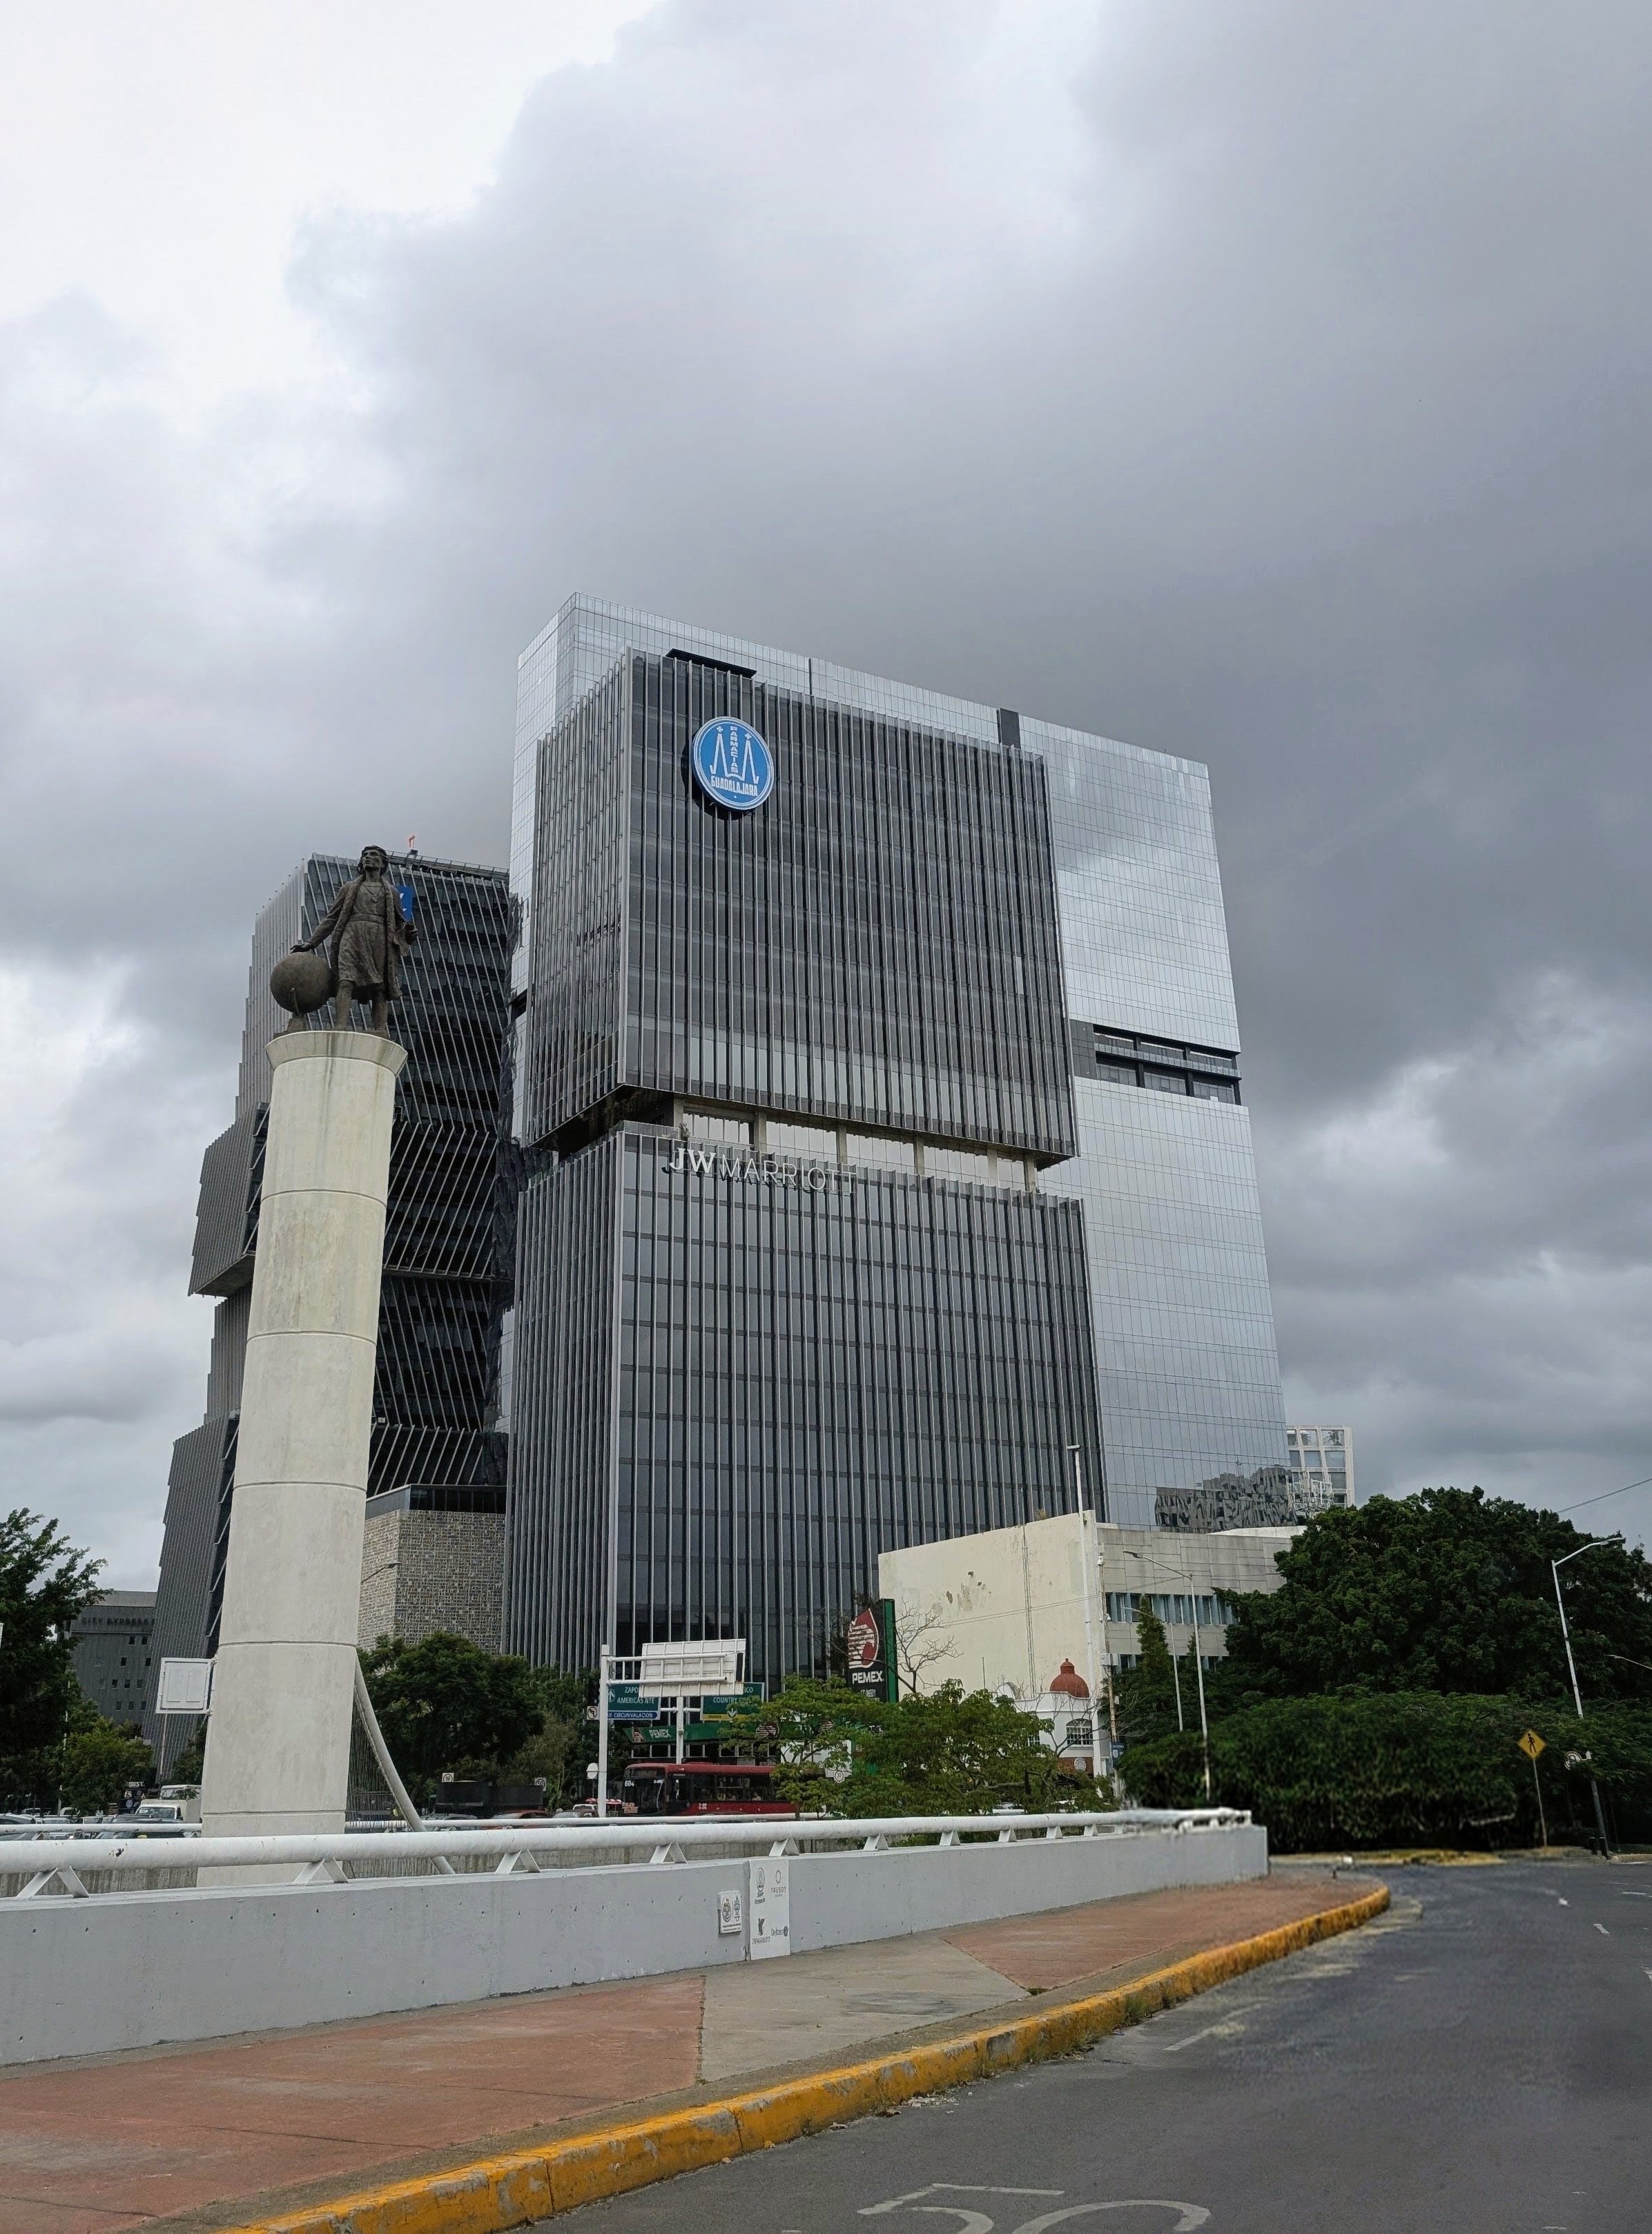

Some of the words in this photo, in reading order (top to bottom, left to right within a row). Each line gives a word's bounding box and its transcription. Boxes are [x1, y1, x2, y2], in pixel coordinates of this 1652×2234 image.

[730, 726, 738, 773] FARMACIAS
[710, 775, 758, 797] GUADALAJARA
[668, 1147, 716, 1174] JW
[721, 1154, 857, 1194] MARRIOTT
[81, 1617, 103, 1625] CITY
[106, 1617, 148, 1626] EXPRESS
[852, 1670, 883, 1684] PEMEX
[648, 1729, 672, 1739] PEMEX
